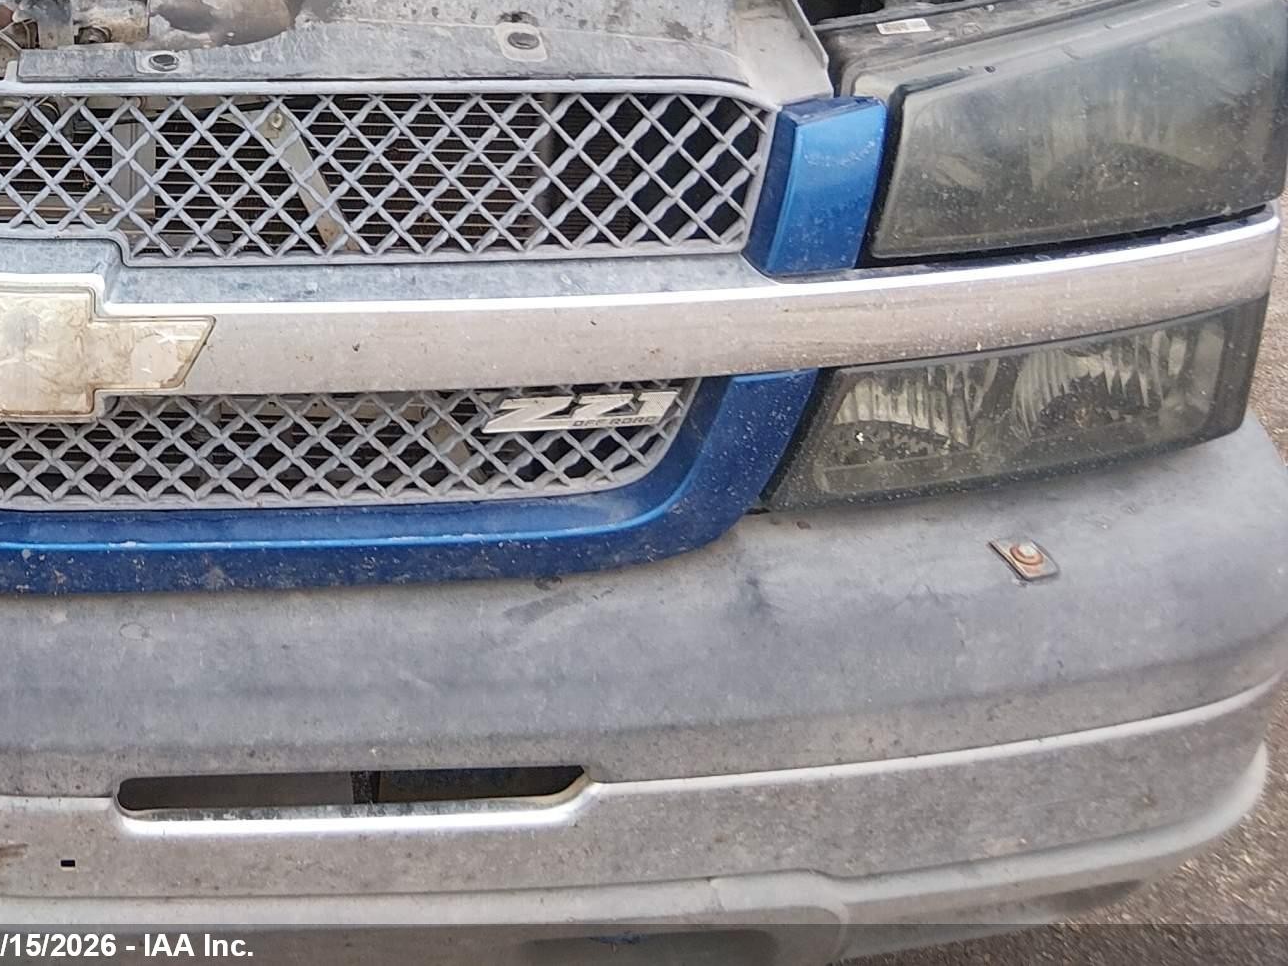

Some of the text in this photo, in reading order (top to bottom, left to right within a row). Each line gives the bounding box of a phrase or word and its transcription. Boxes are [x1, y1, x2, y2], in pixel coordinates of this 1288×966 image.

[481, 390, 680, 434] Z71
[572, 415, 658, 428] OFF ROAD
